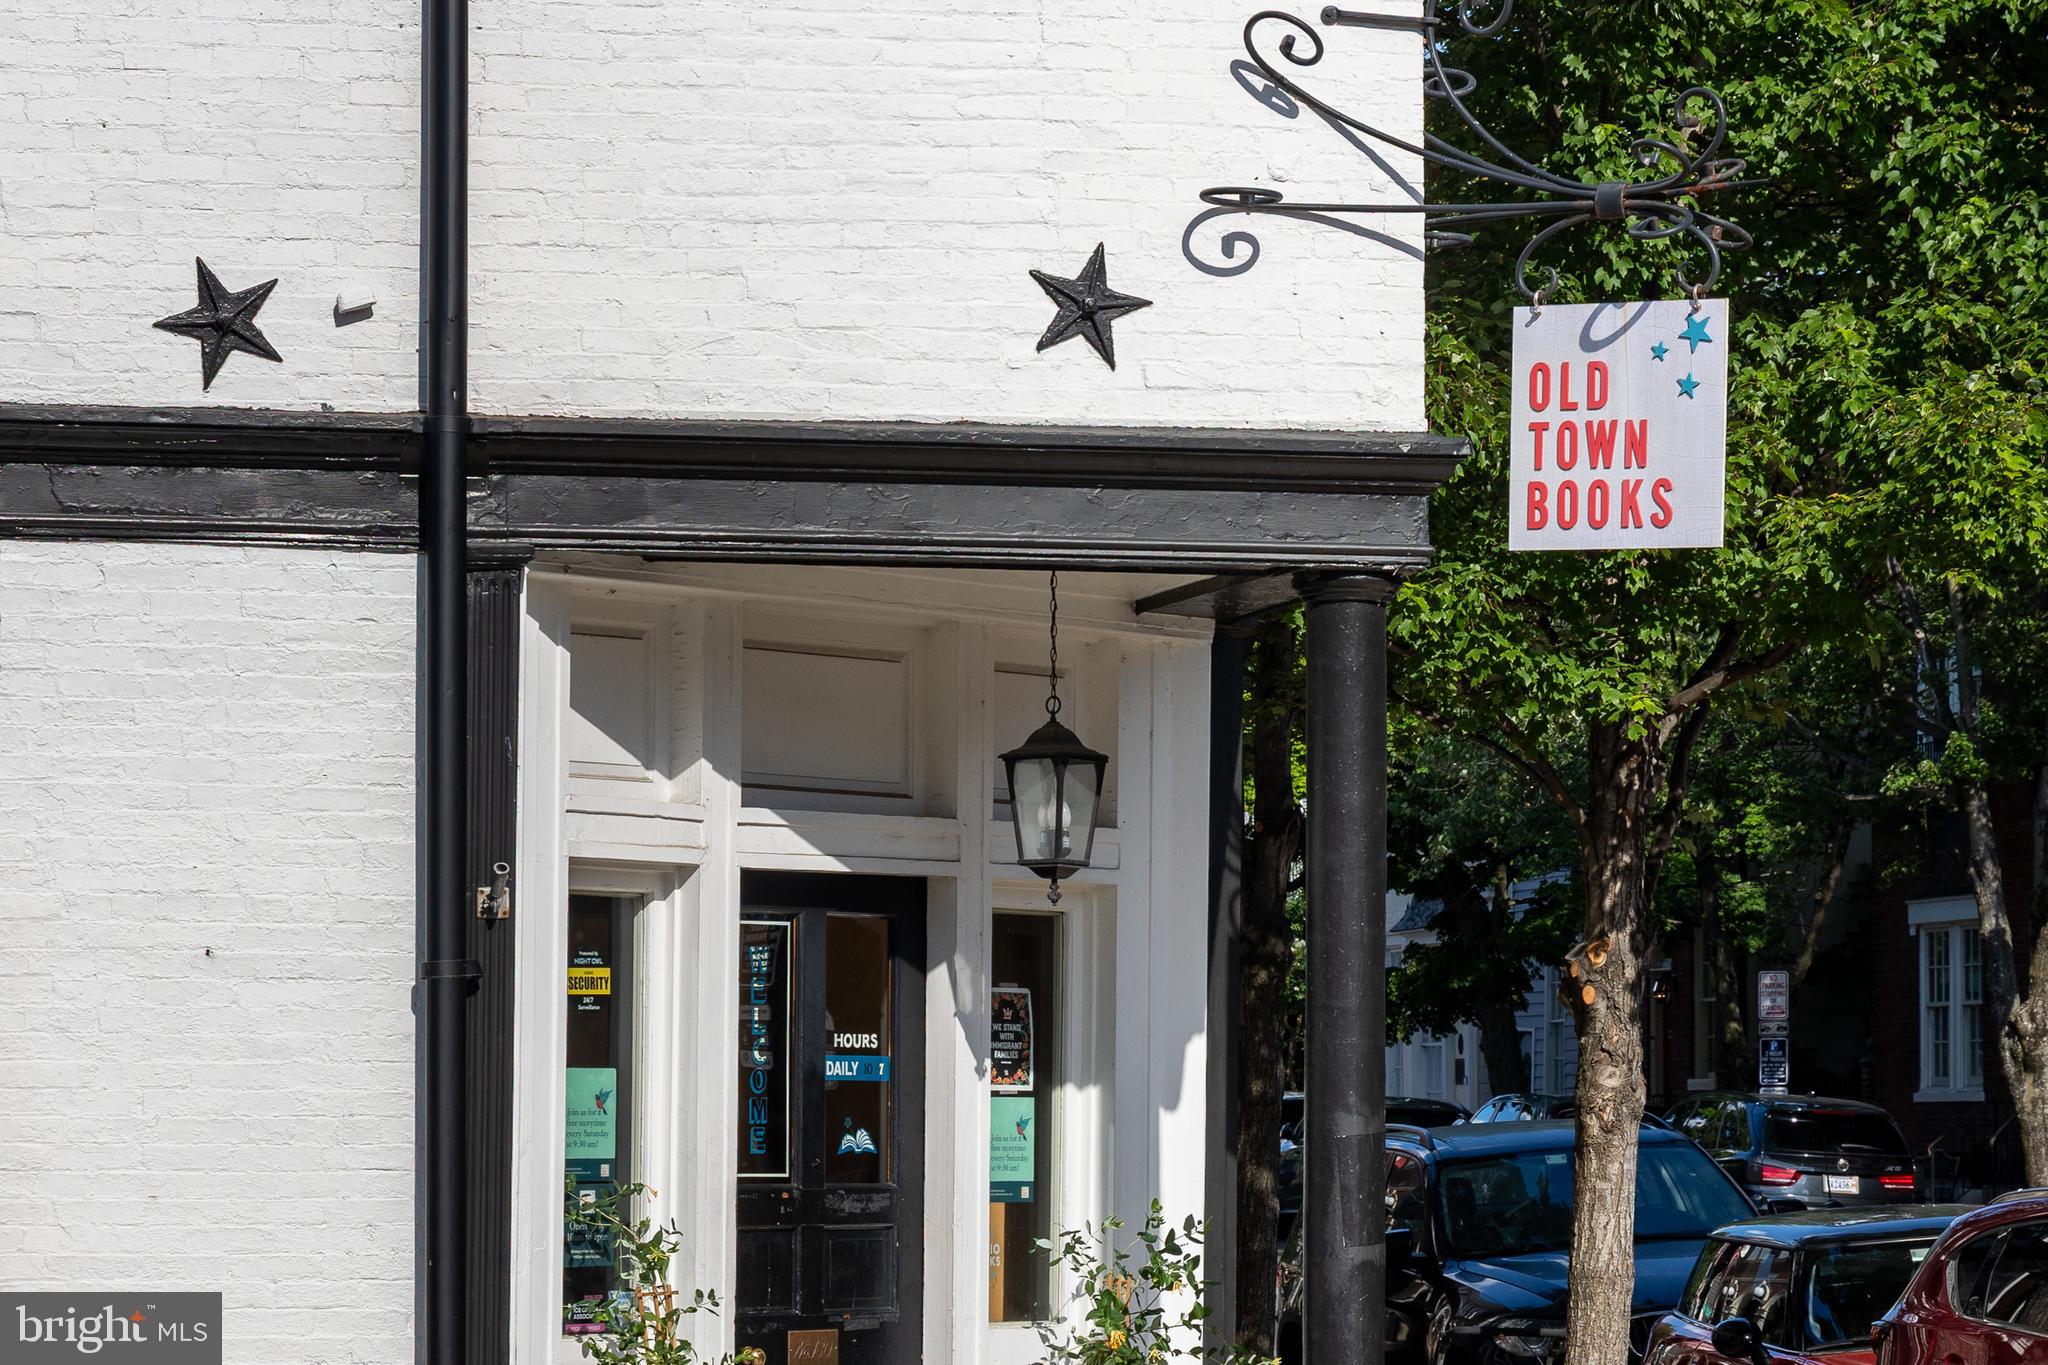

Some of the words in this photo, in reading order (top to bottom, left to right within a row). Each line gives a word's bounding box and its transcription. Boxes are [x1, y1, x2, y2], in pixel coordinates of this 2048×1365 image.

[1529, 361, 1609, 412] OLD
[1528, 418, 1648, 471] TOWN
[1526, 477, 1673, 530] BOOKS
[568, 976, 609, 991] SECURITY
[992, 1023, 1002, 1031] WE
[1003, 1023, 1022, 1031] STAND
[833, 1033, 879, 1049] HOURS
[999, 1032, 1015, 1040] WITH
[748, 945, 769, 1155] WELCOME
[991, 1041, 1023, 1050] MMIGRANT
[993, 1050, 1019, 1059] FAMILIES
[825, 1060, 859, 1076] DAILY
[583, 1128, 609, 1140] Saturday
[569, 1221, 588, 1231] Open
